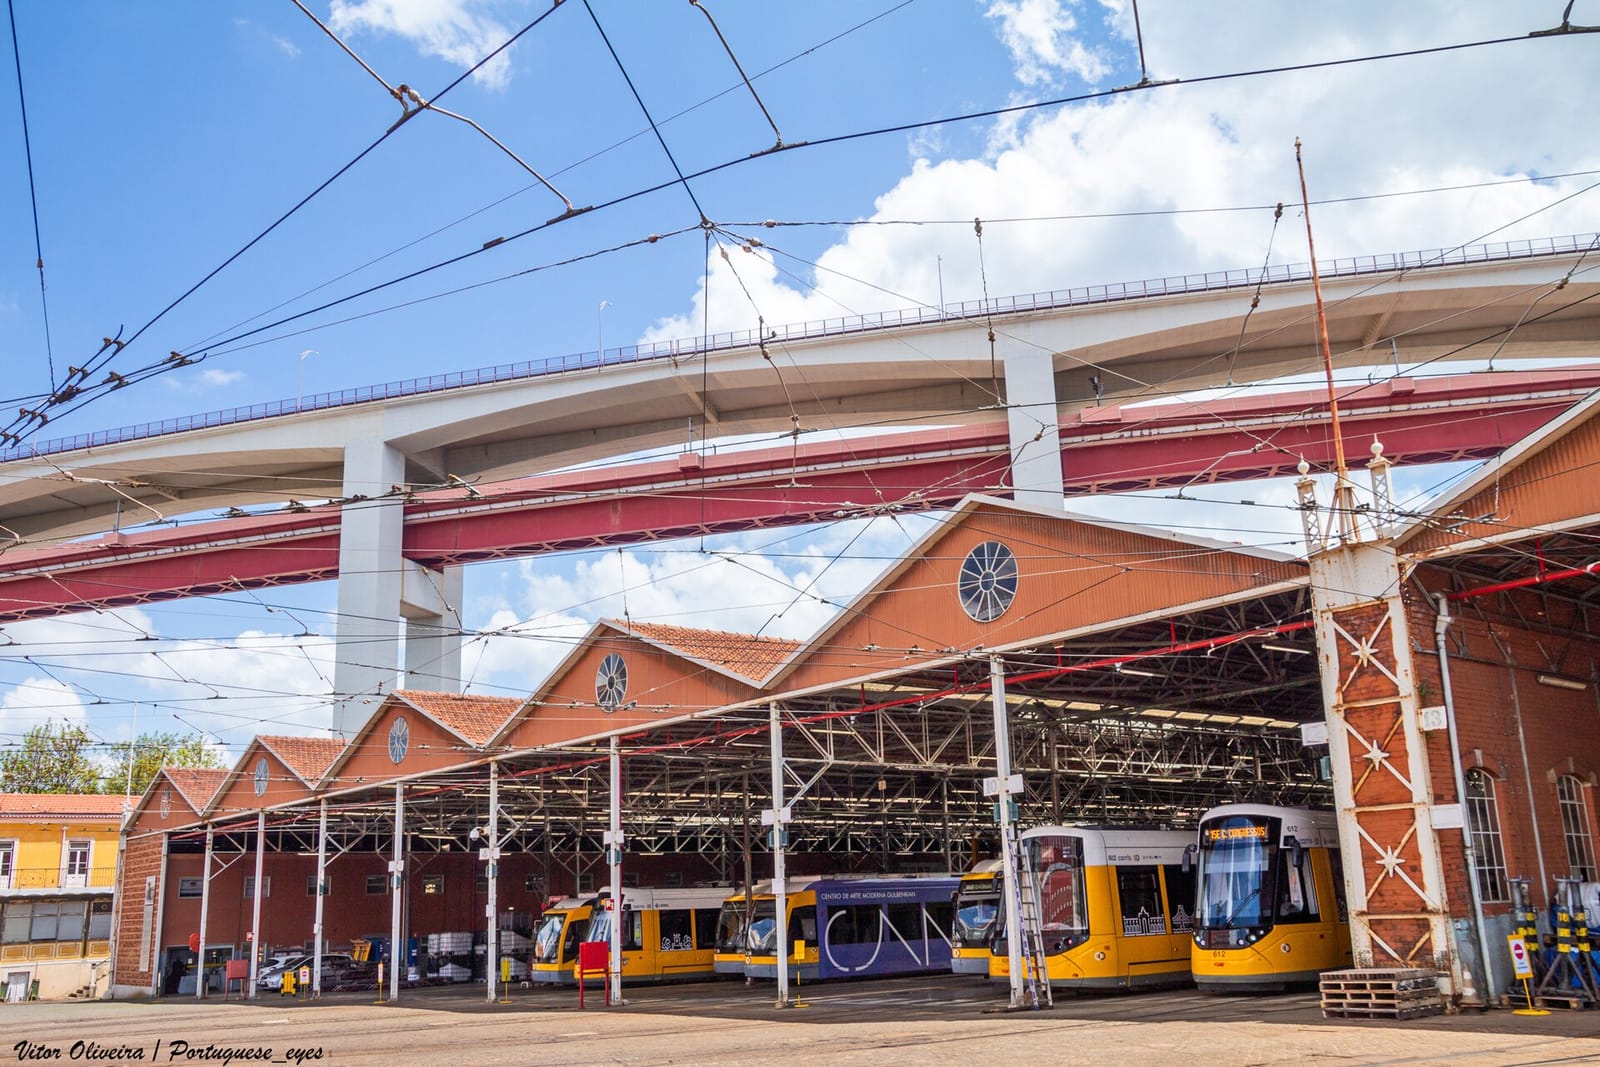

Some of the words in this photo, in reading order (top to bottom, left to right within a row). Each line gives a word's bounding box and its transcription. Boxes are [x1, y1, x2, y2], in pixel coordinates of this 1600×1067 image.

[1286, 825, 1298, 833] 612
[862, 891, 886, 899] MODERNA
[1212, 950, 1226, 958] 612
